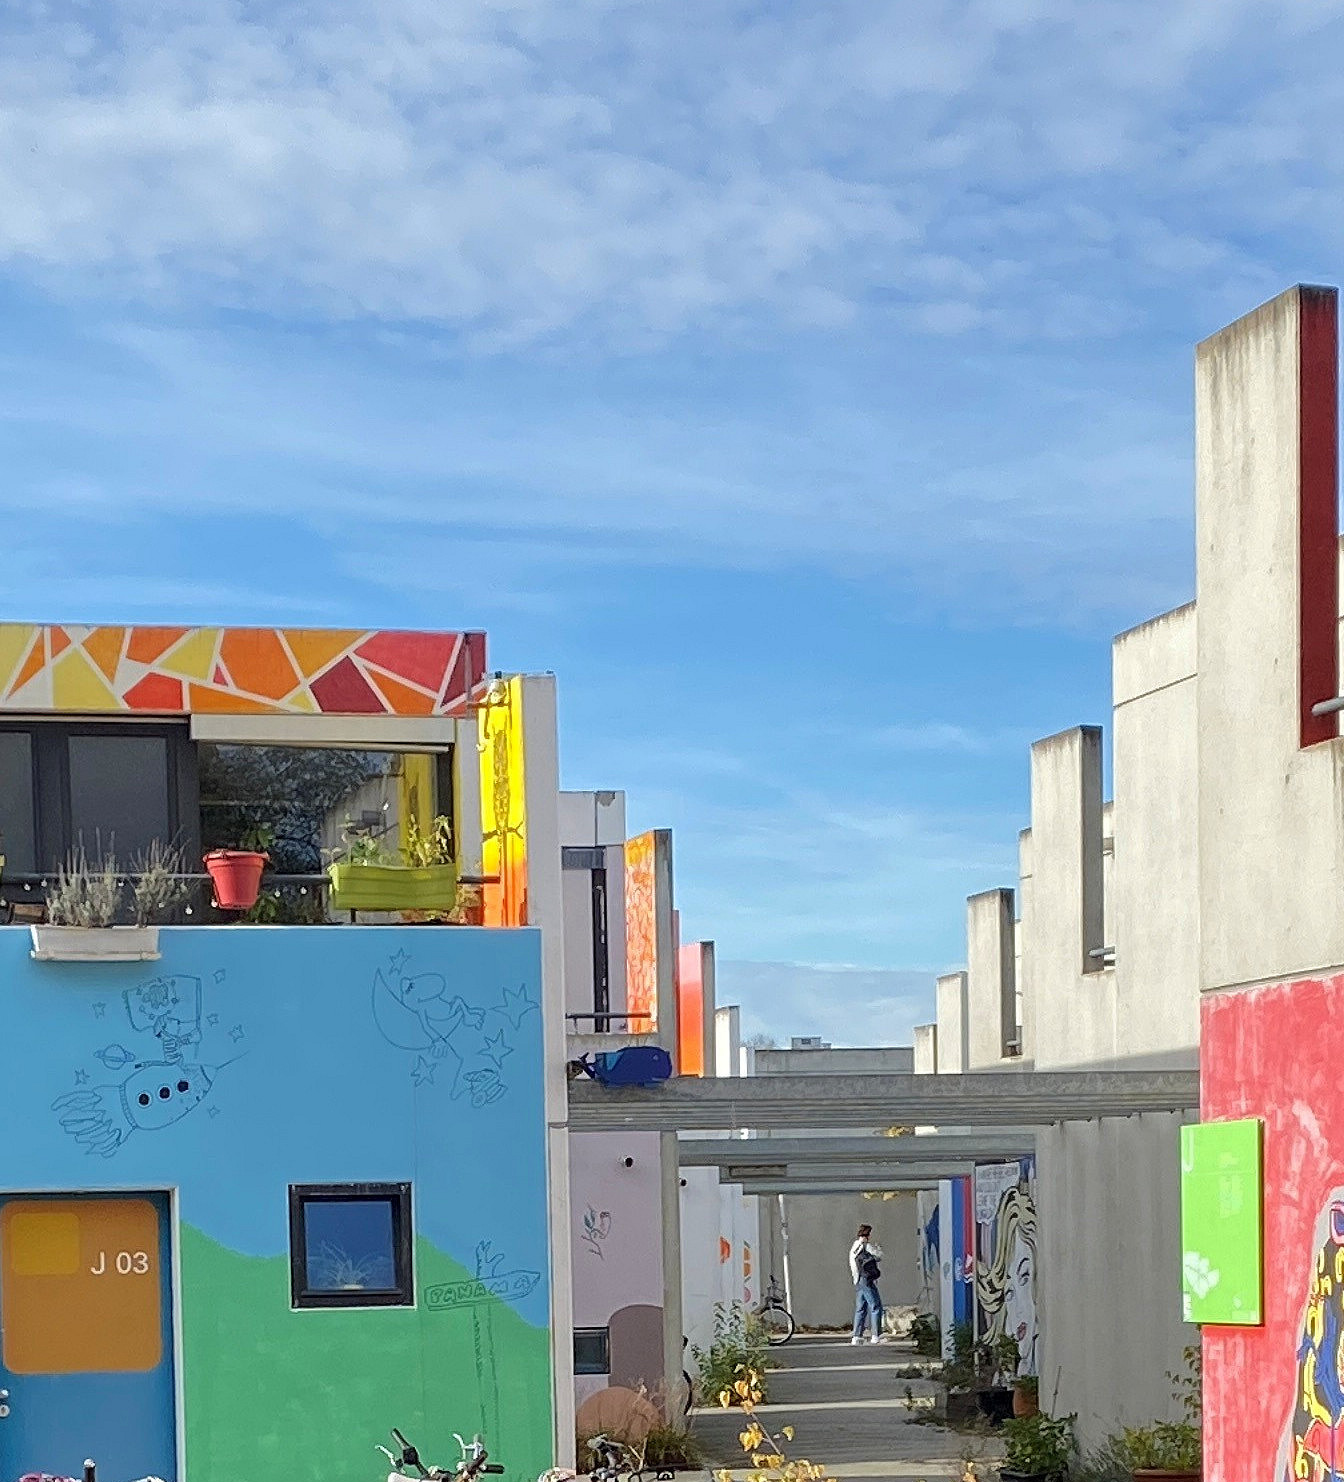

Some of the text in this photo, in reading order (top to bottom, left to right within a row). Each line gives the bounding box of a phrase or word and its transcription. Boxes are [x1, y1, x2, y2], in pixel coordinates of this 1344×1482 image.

[91, 1252, 148, 1274] J 03
[430, 1276, 531, 1303] PANAMA
